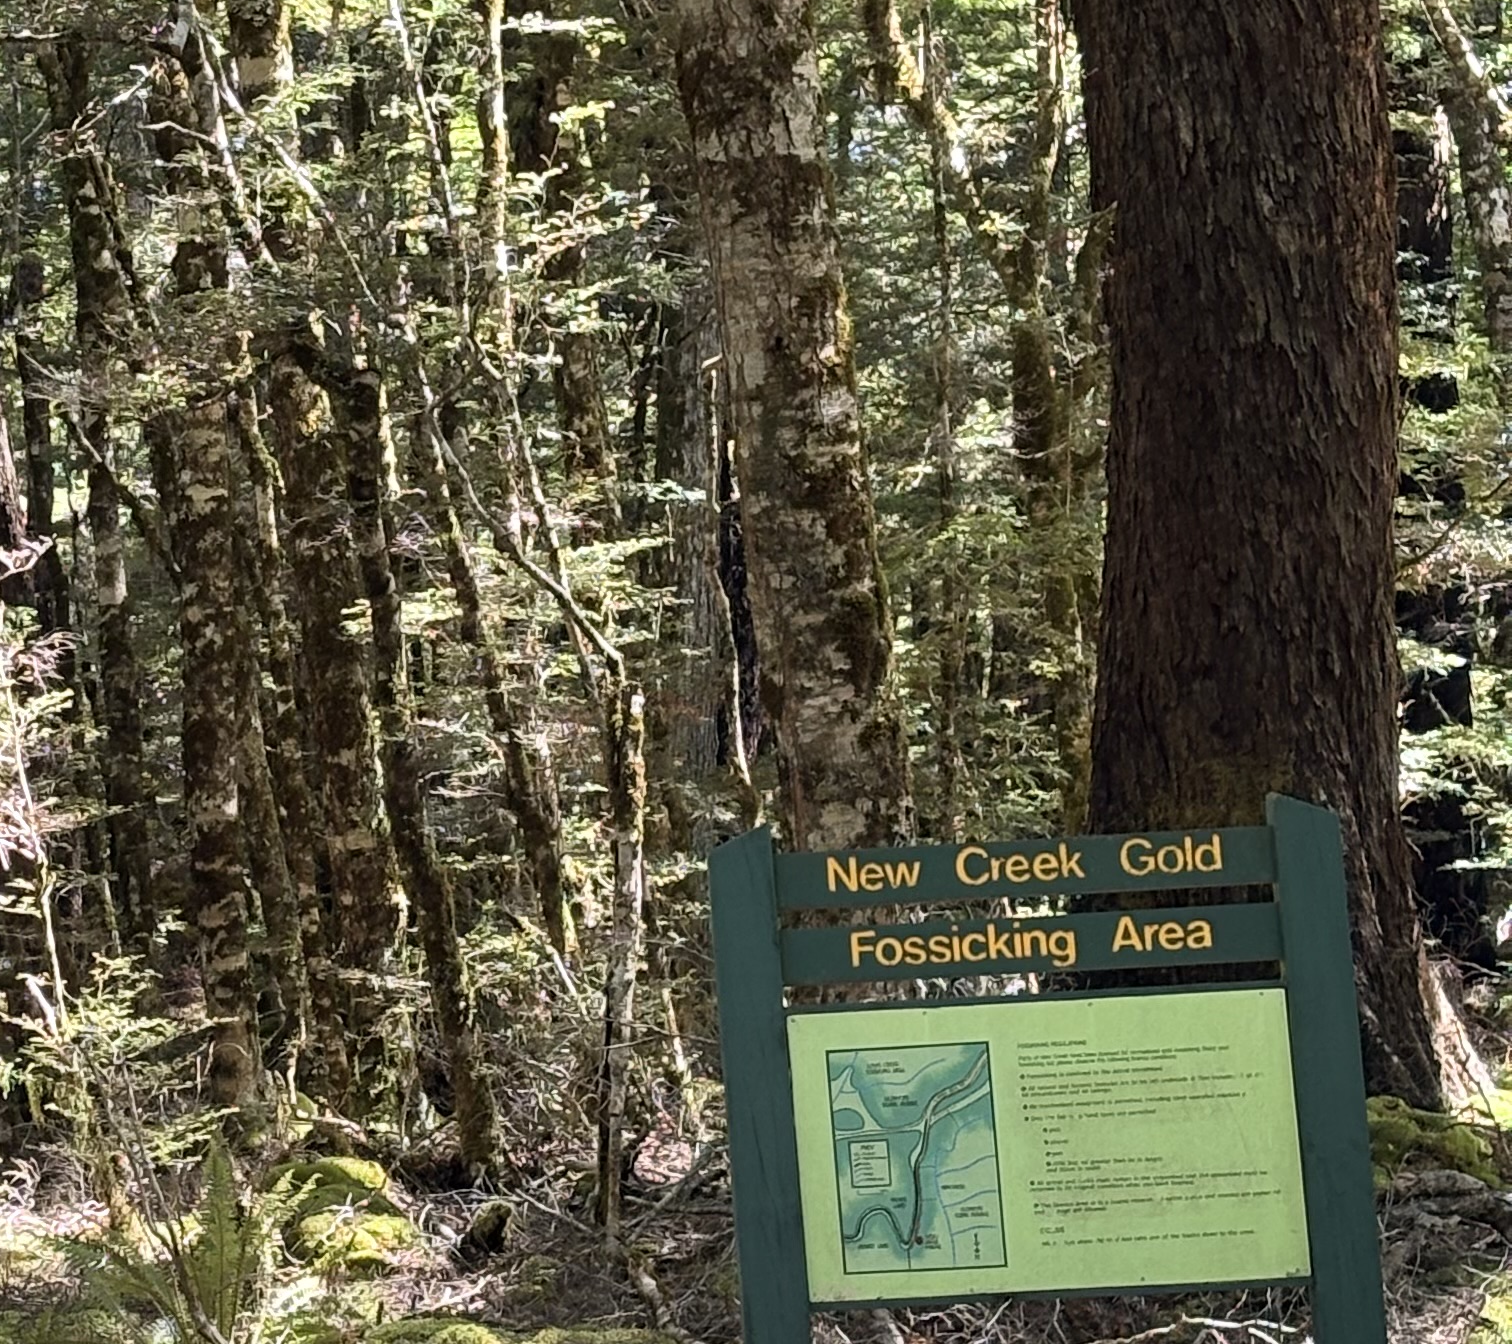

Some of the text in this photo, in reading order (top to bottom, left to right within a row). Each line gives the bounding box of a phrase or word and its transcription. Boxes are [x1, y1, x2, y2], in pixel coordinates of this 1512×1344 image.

[826, 832, 1223, 893] New Creek Gold
[849, 915, 1213, 968] Fossicking Area
